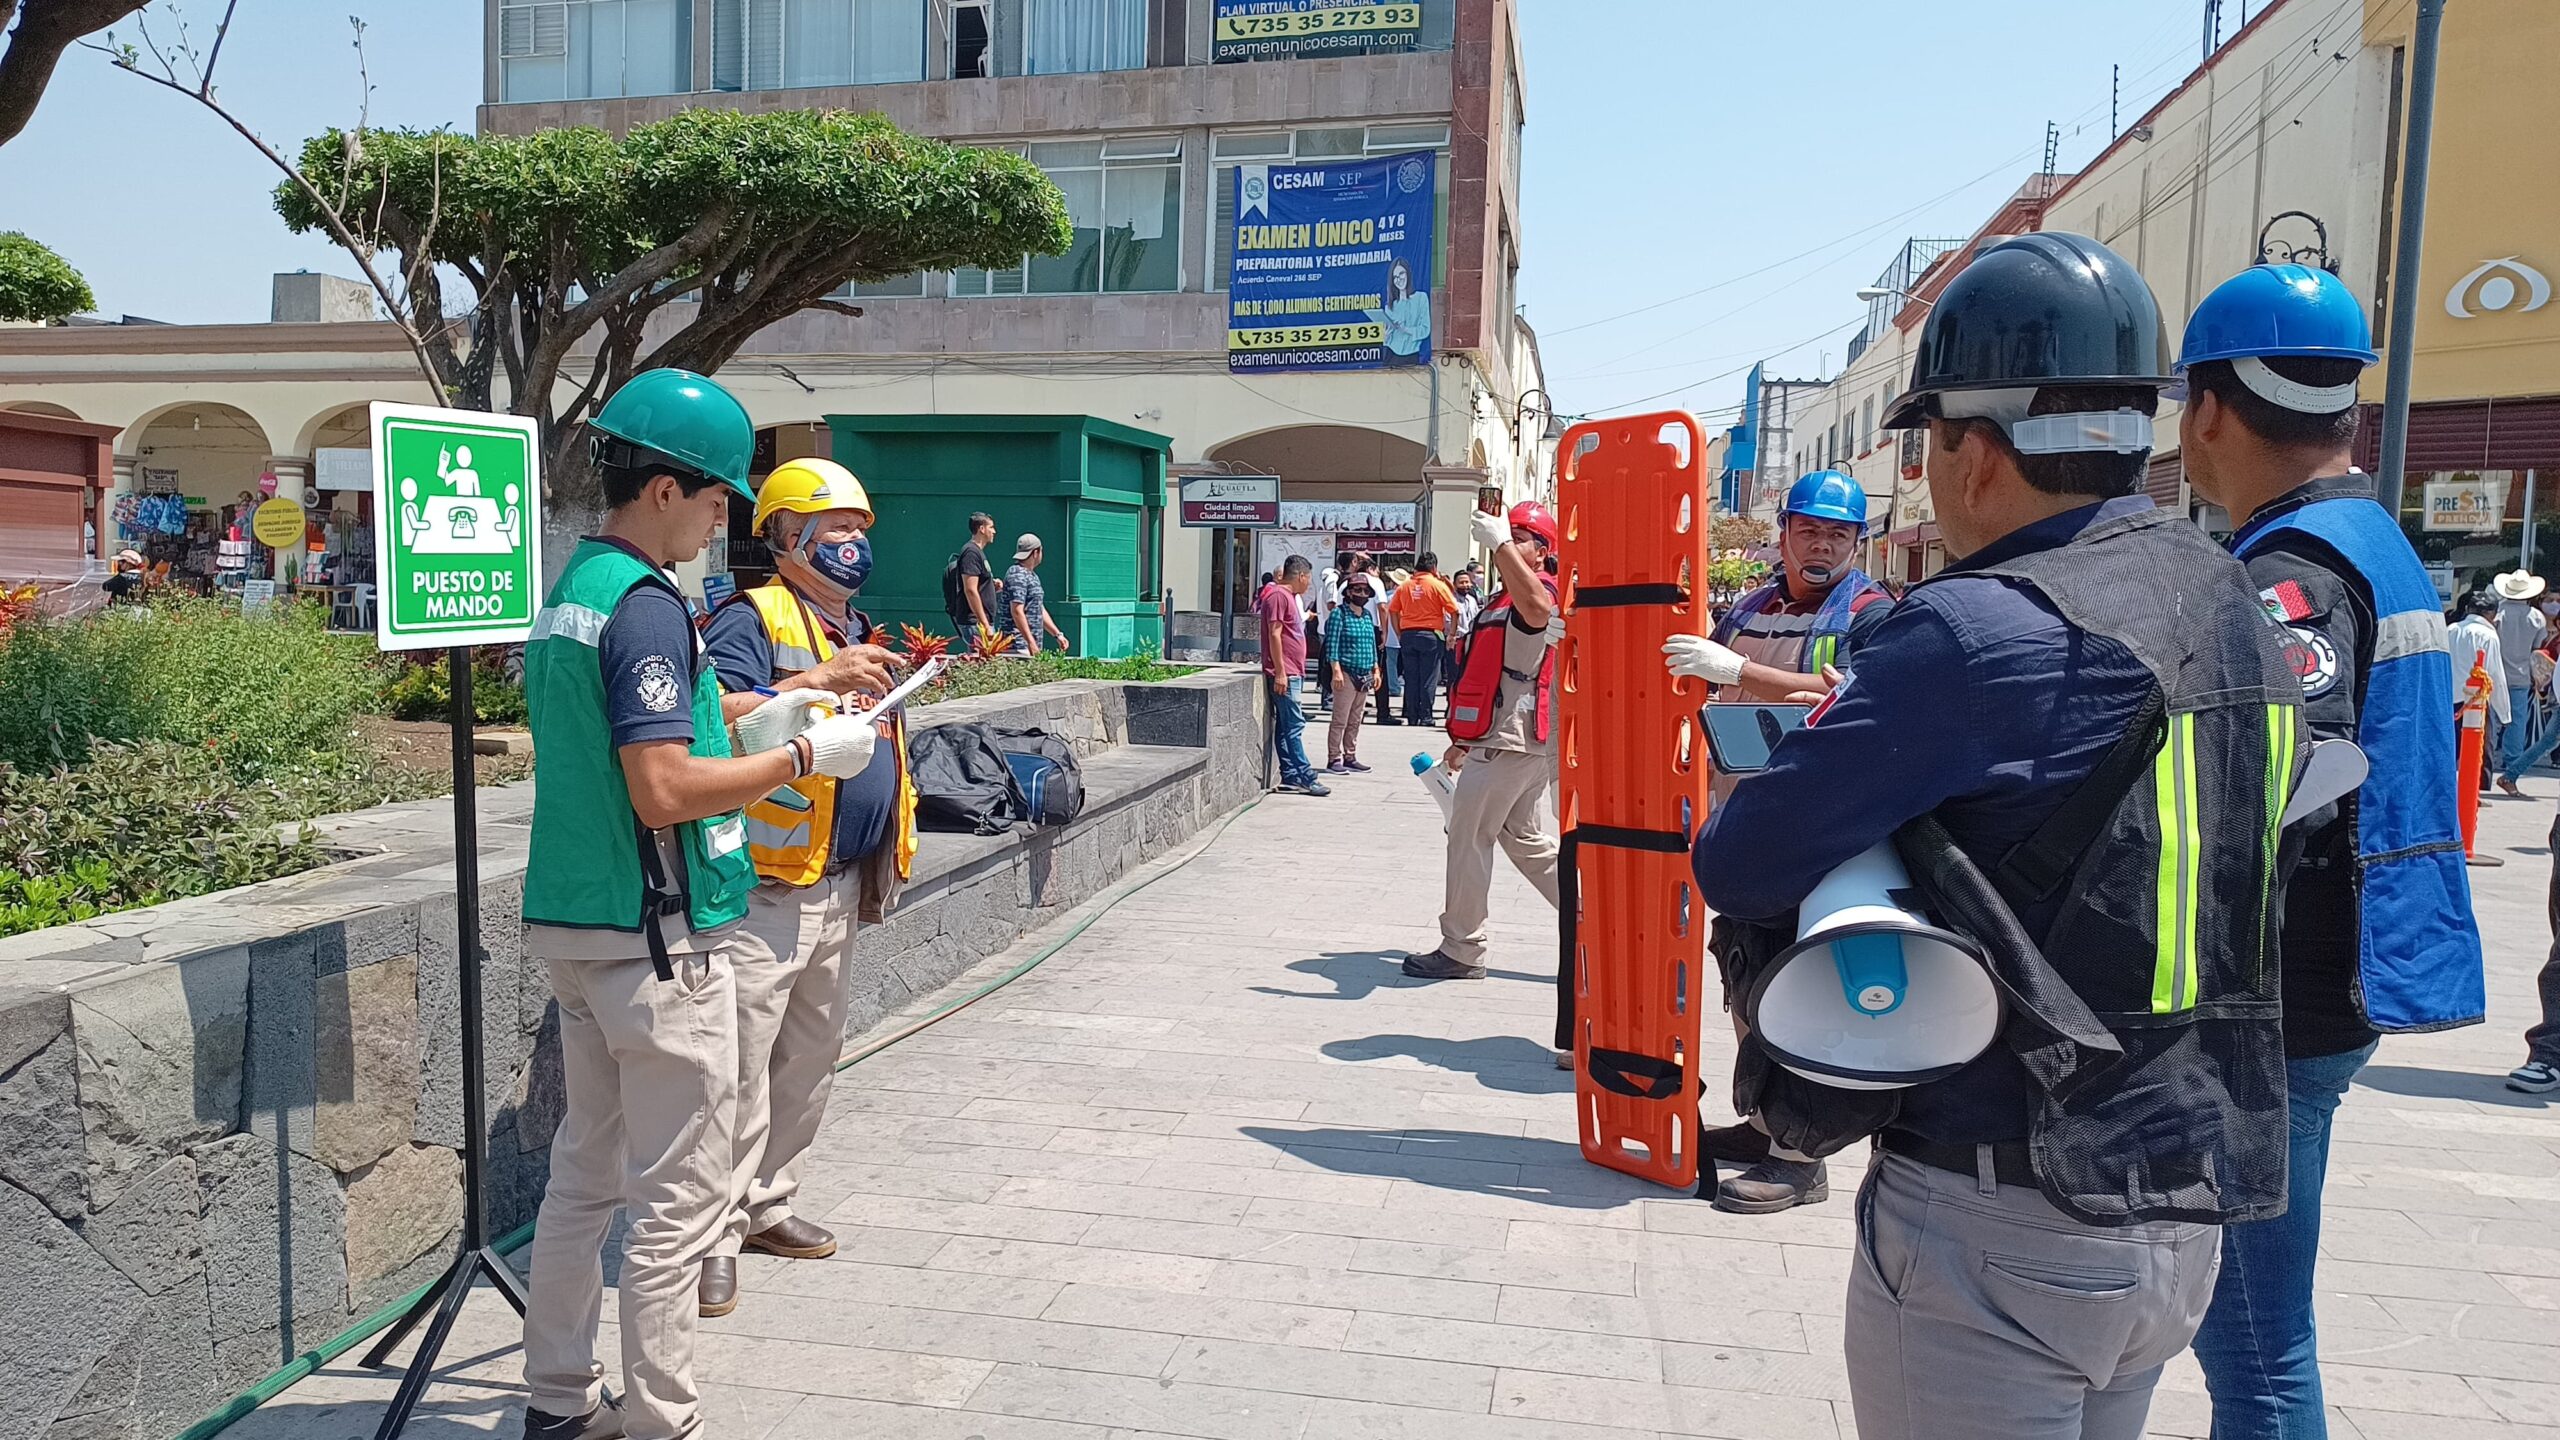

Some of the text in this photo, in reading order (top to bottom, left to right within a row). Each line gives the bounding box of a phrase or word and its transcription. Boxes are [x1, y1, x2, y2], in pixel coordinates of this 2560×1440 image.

[1220, 4, 1246, 17] PLAN
[1249, 1, 1296, 15] VIRTUAL
[1299, 0, 1307, 12] O
[1246, 8, 1414, 33] 735 35 273 93
[1219, 32, 1414, 56] examenunicocesam.com
[1273, 171, 1362, 190] CESAM SEP
[1378, 213, 1405, 230] 4 Y 8
[1237, 218, 1374, 250] EXAMEN ÚNICO
[1378, 230, 1405, 243] MESES
[1236, 249, 1392, 271] PREPARATORIA Y SECUNDARIA
[1307, 273, 1322, 281] SEP
[1234, 293, 1381, 316] MÁS DE 1,000 ALUMNOS CERTIFICADOS
[1252, 326, 1380, 344] 735 35 273 93
[1230, 347, 1381, 366] examenunicocesam.com
[1199, 512, 1260, 520] Ciudad hermosa
[1204, 503, 1255, 513] Ciudad limpia
[412, 570, 514, 594] PUESTO DE
[425, 594, 503, 618] MANDO
[631, 655, 663, 674] DONADO
